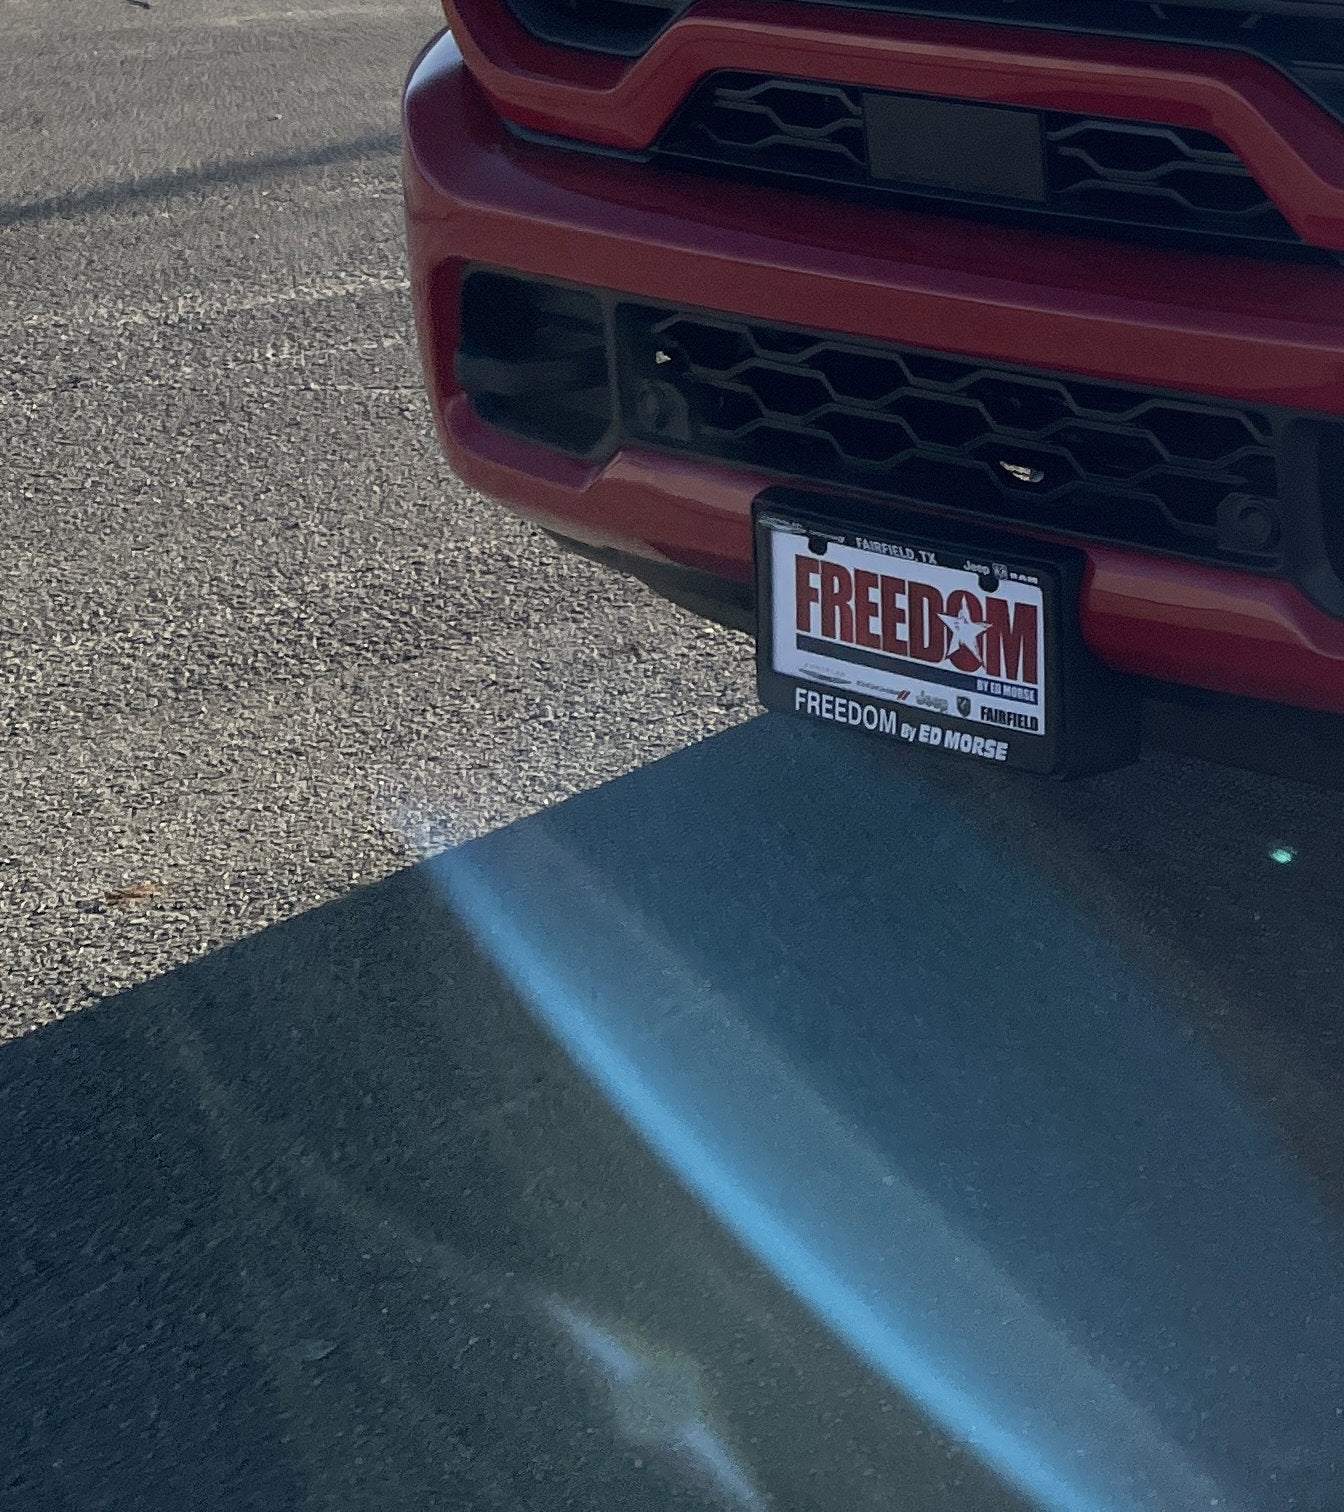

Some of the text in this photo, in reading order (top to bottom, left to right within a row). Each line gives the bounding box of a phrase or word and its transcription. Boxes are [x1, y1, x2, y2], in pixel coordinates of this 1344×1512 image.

[918, 550, 938, 565] TX
[963, 560, 991, 575] Jeep
[795, 554, 1038, 684] FREEDOM
[977, 679, 989, 692] BY
[795, 687, 897, 736] FREEDOM
[918, 724, 943, 746] ED
[944, 730, 1009, 762] MORSE
[980, 706, 1038, 731] FAIRFIELD
